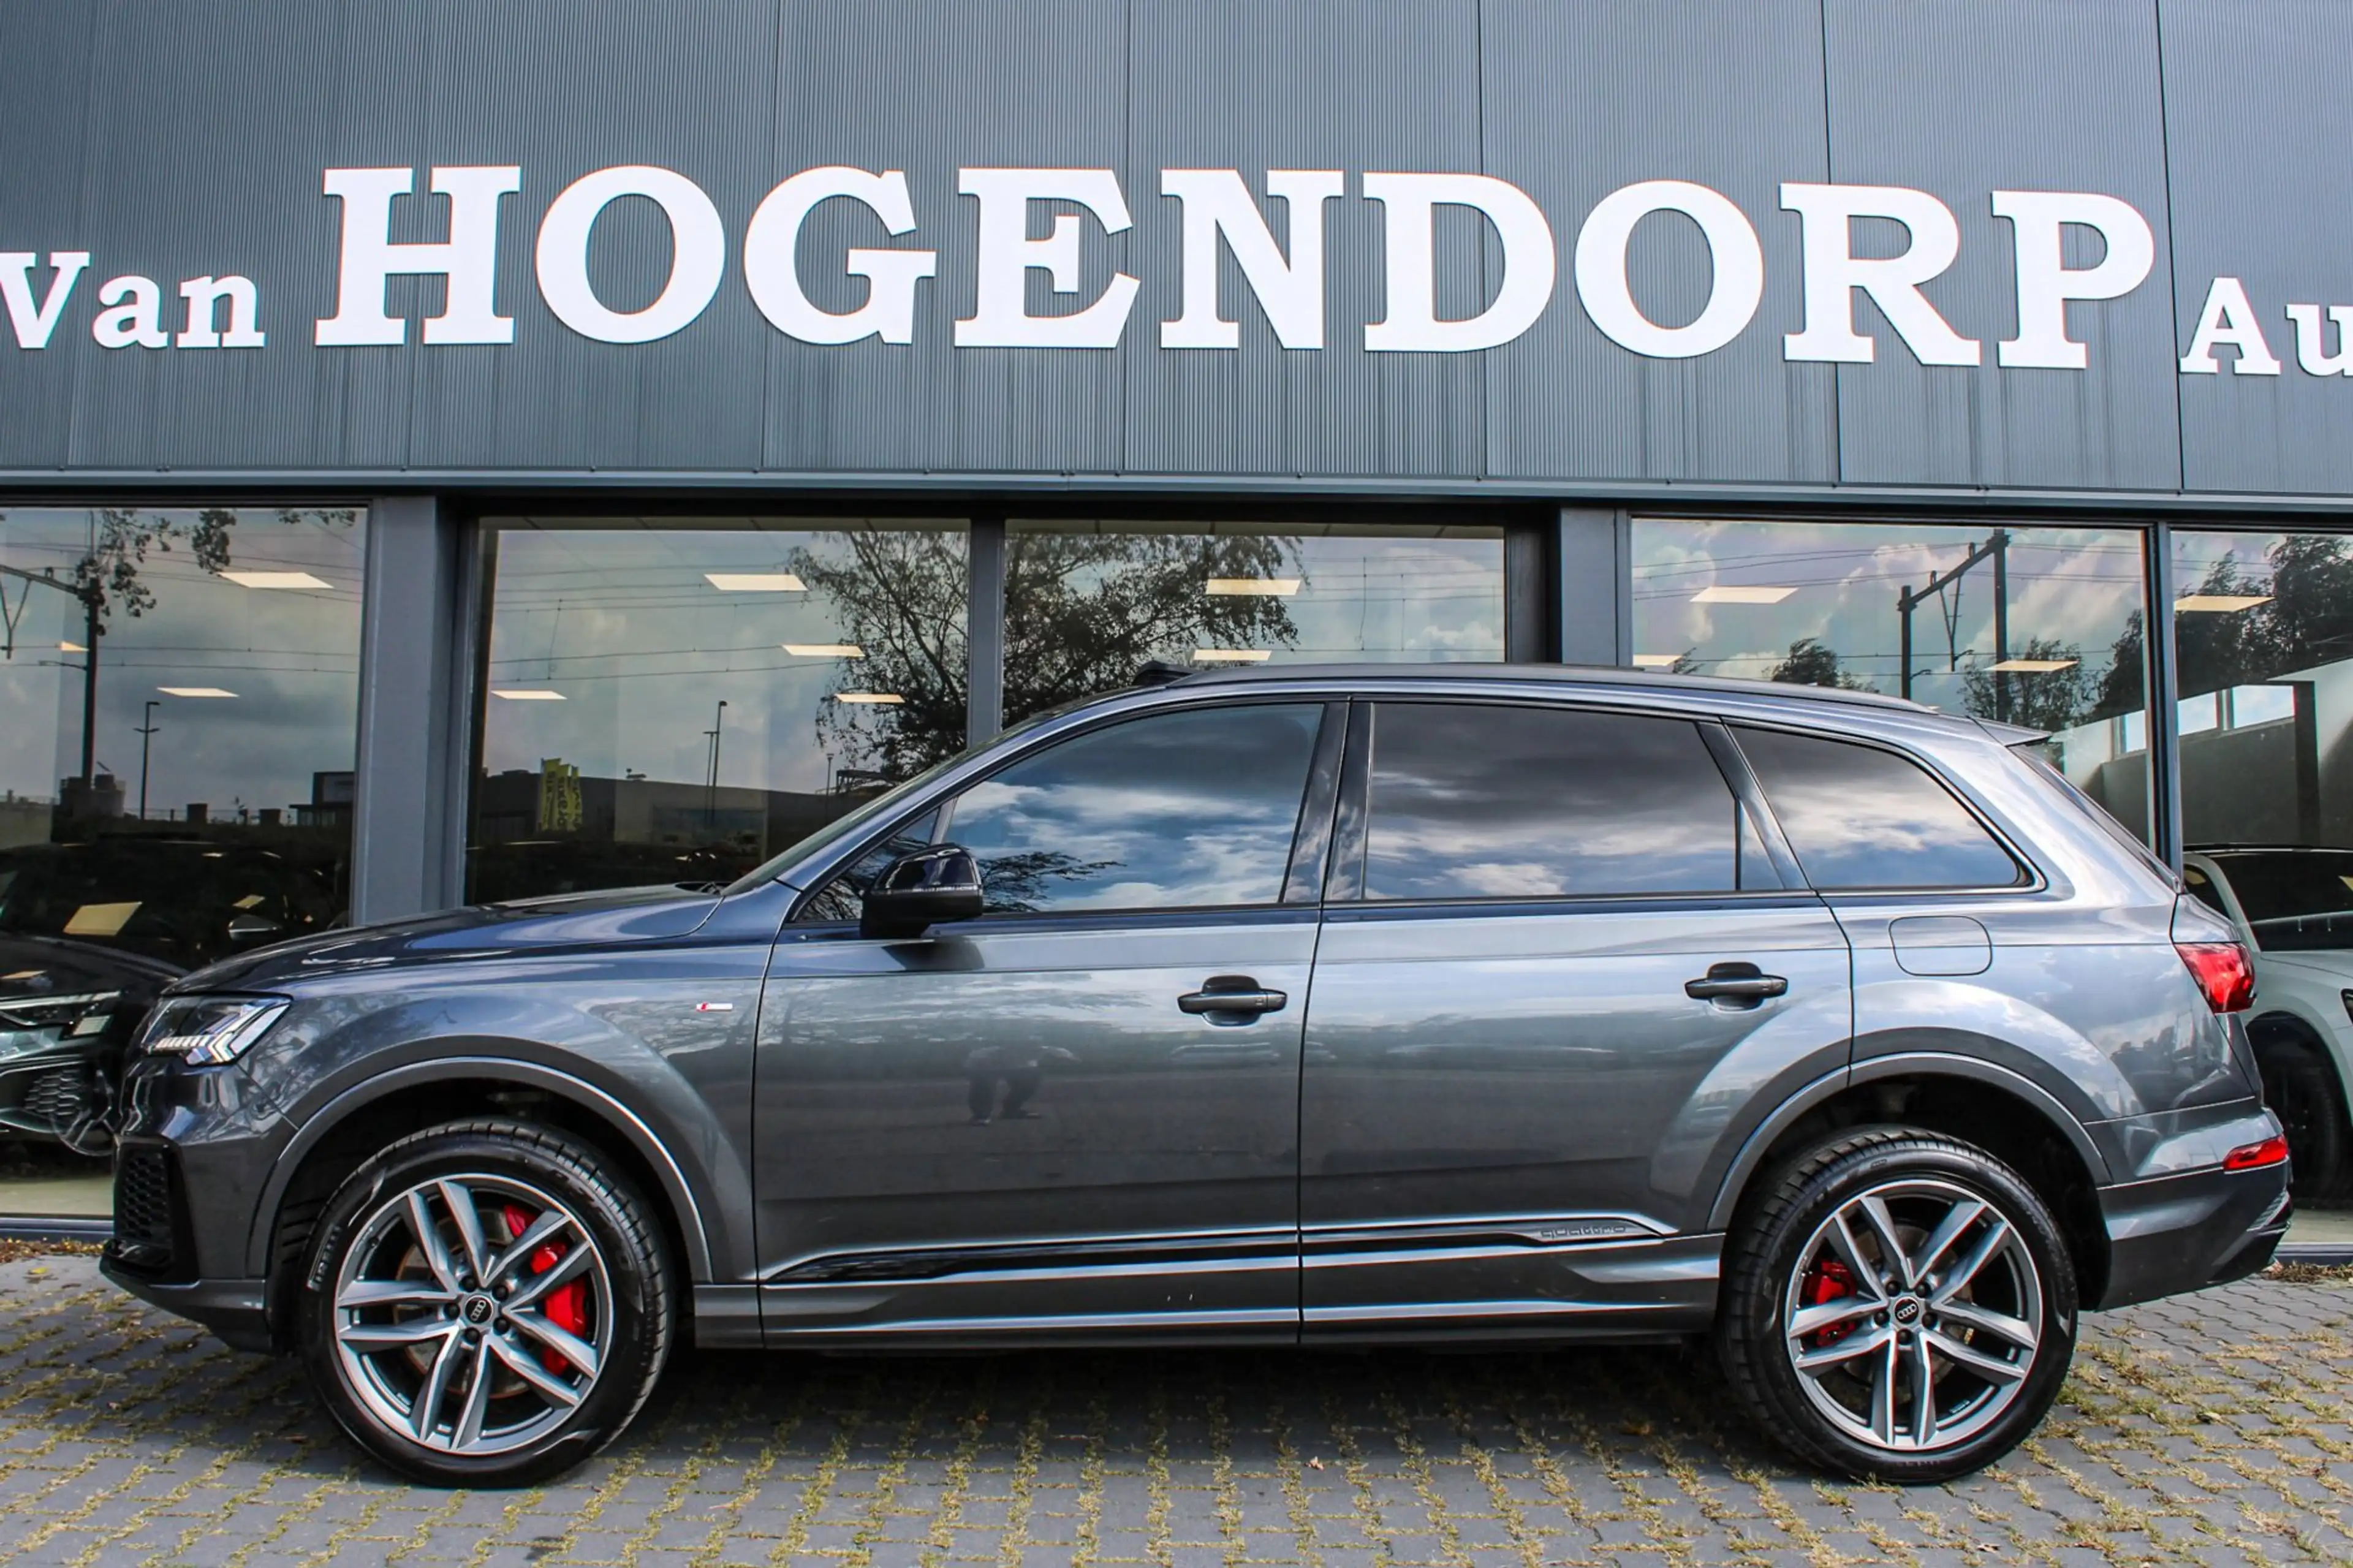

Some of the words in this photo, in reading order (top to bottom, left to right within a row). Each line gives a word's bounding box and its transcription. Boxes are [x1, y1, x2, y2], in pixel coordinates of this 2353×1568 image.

[0, 251, 265, 349] Van
[315, 165, 2155, 369] HOGENDORP
[2179, 276, 2353, 376] Au
